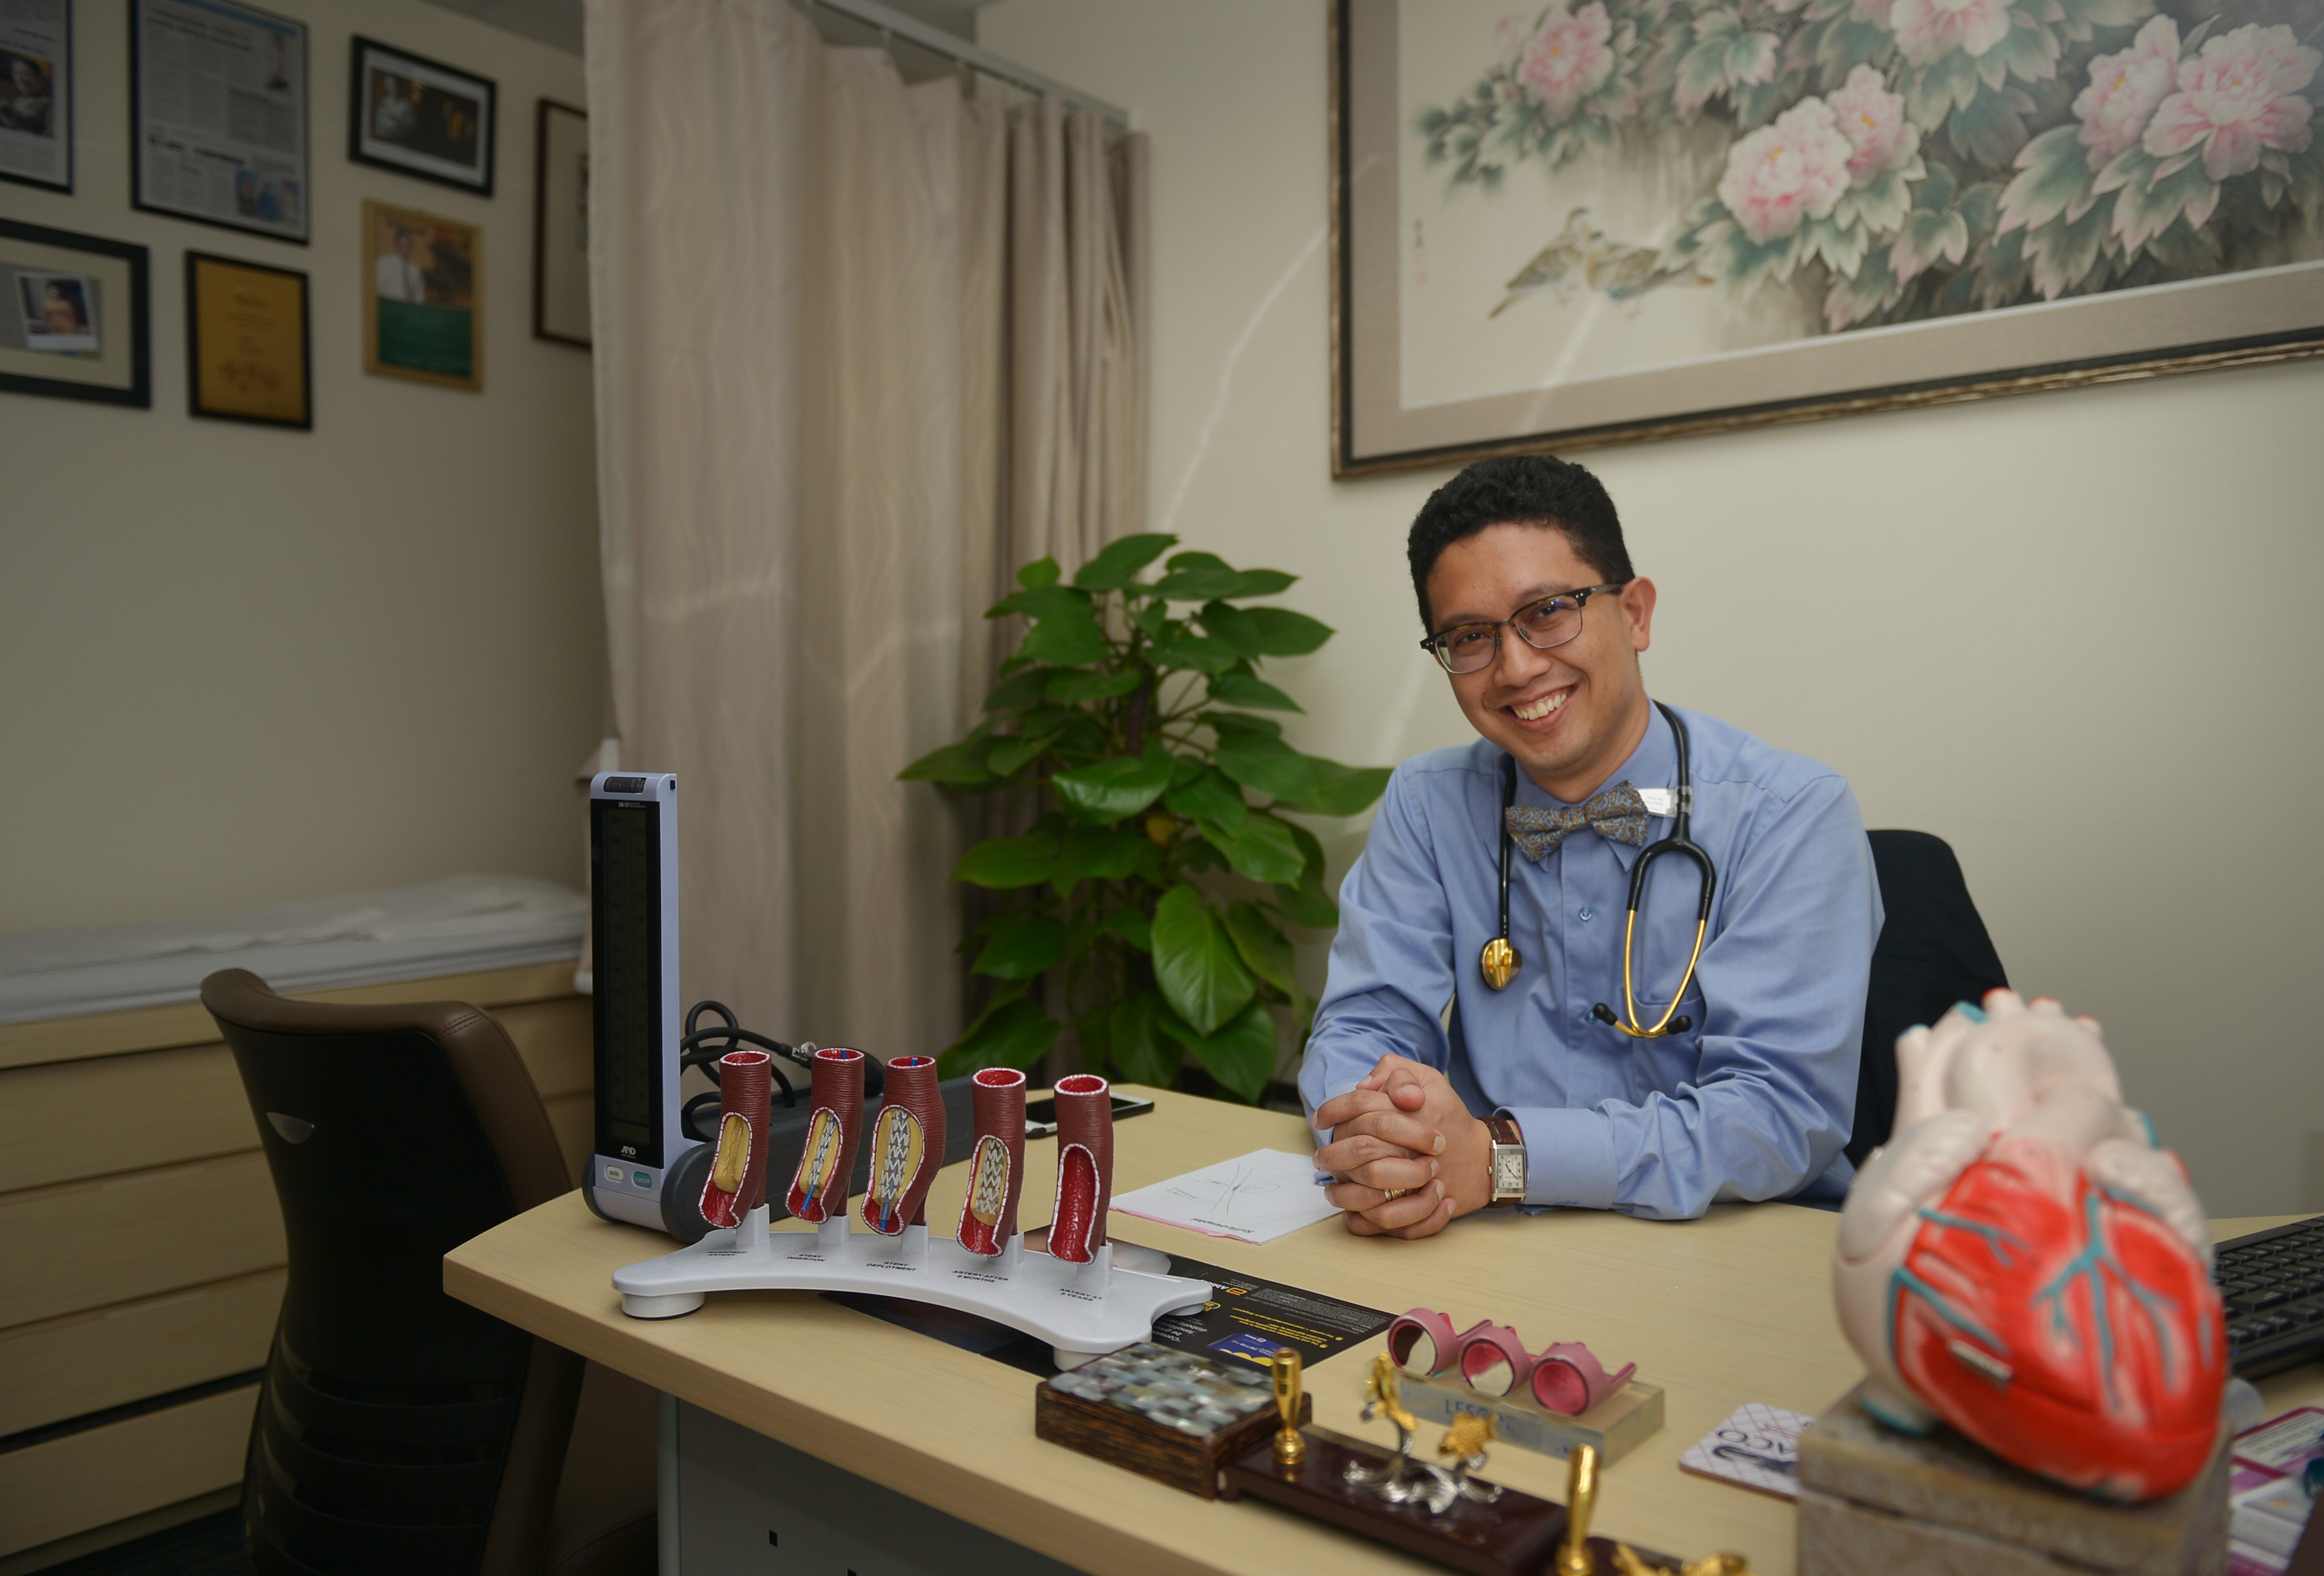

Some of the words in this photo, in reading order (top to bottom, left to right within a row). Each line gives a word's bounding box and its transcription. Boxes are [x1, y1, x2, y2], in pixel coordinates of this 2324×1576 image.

[866, 1263, 917, 1272] DEPLOYMENT
[1059, 1288, 1091, 1296] ARTERY
[1067, 1293, 1093, 1302] YEARS
